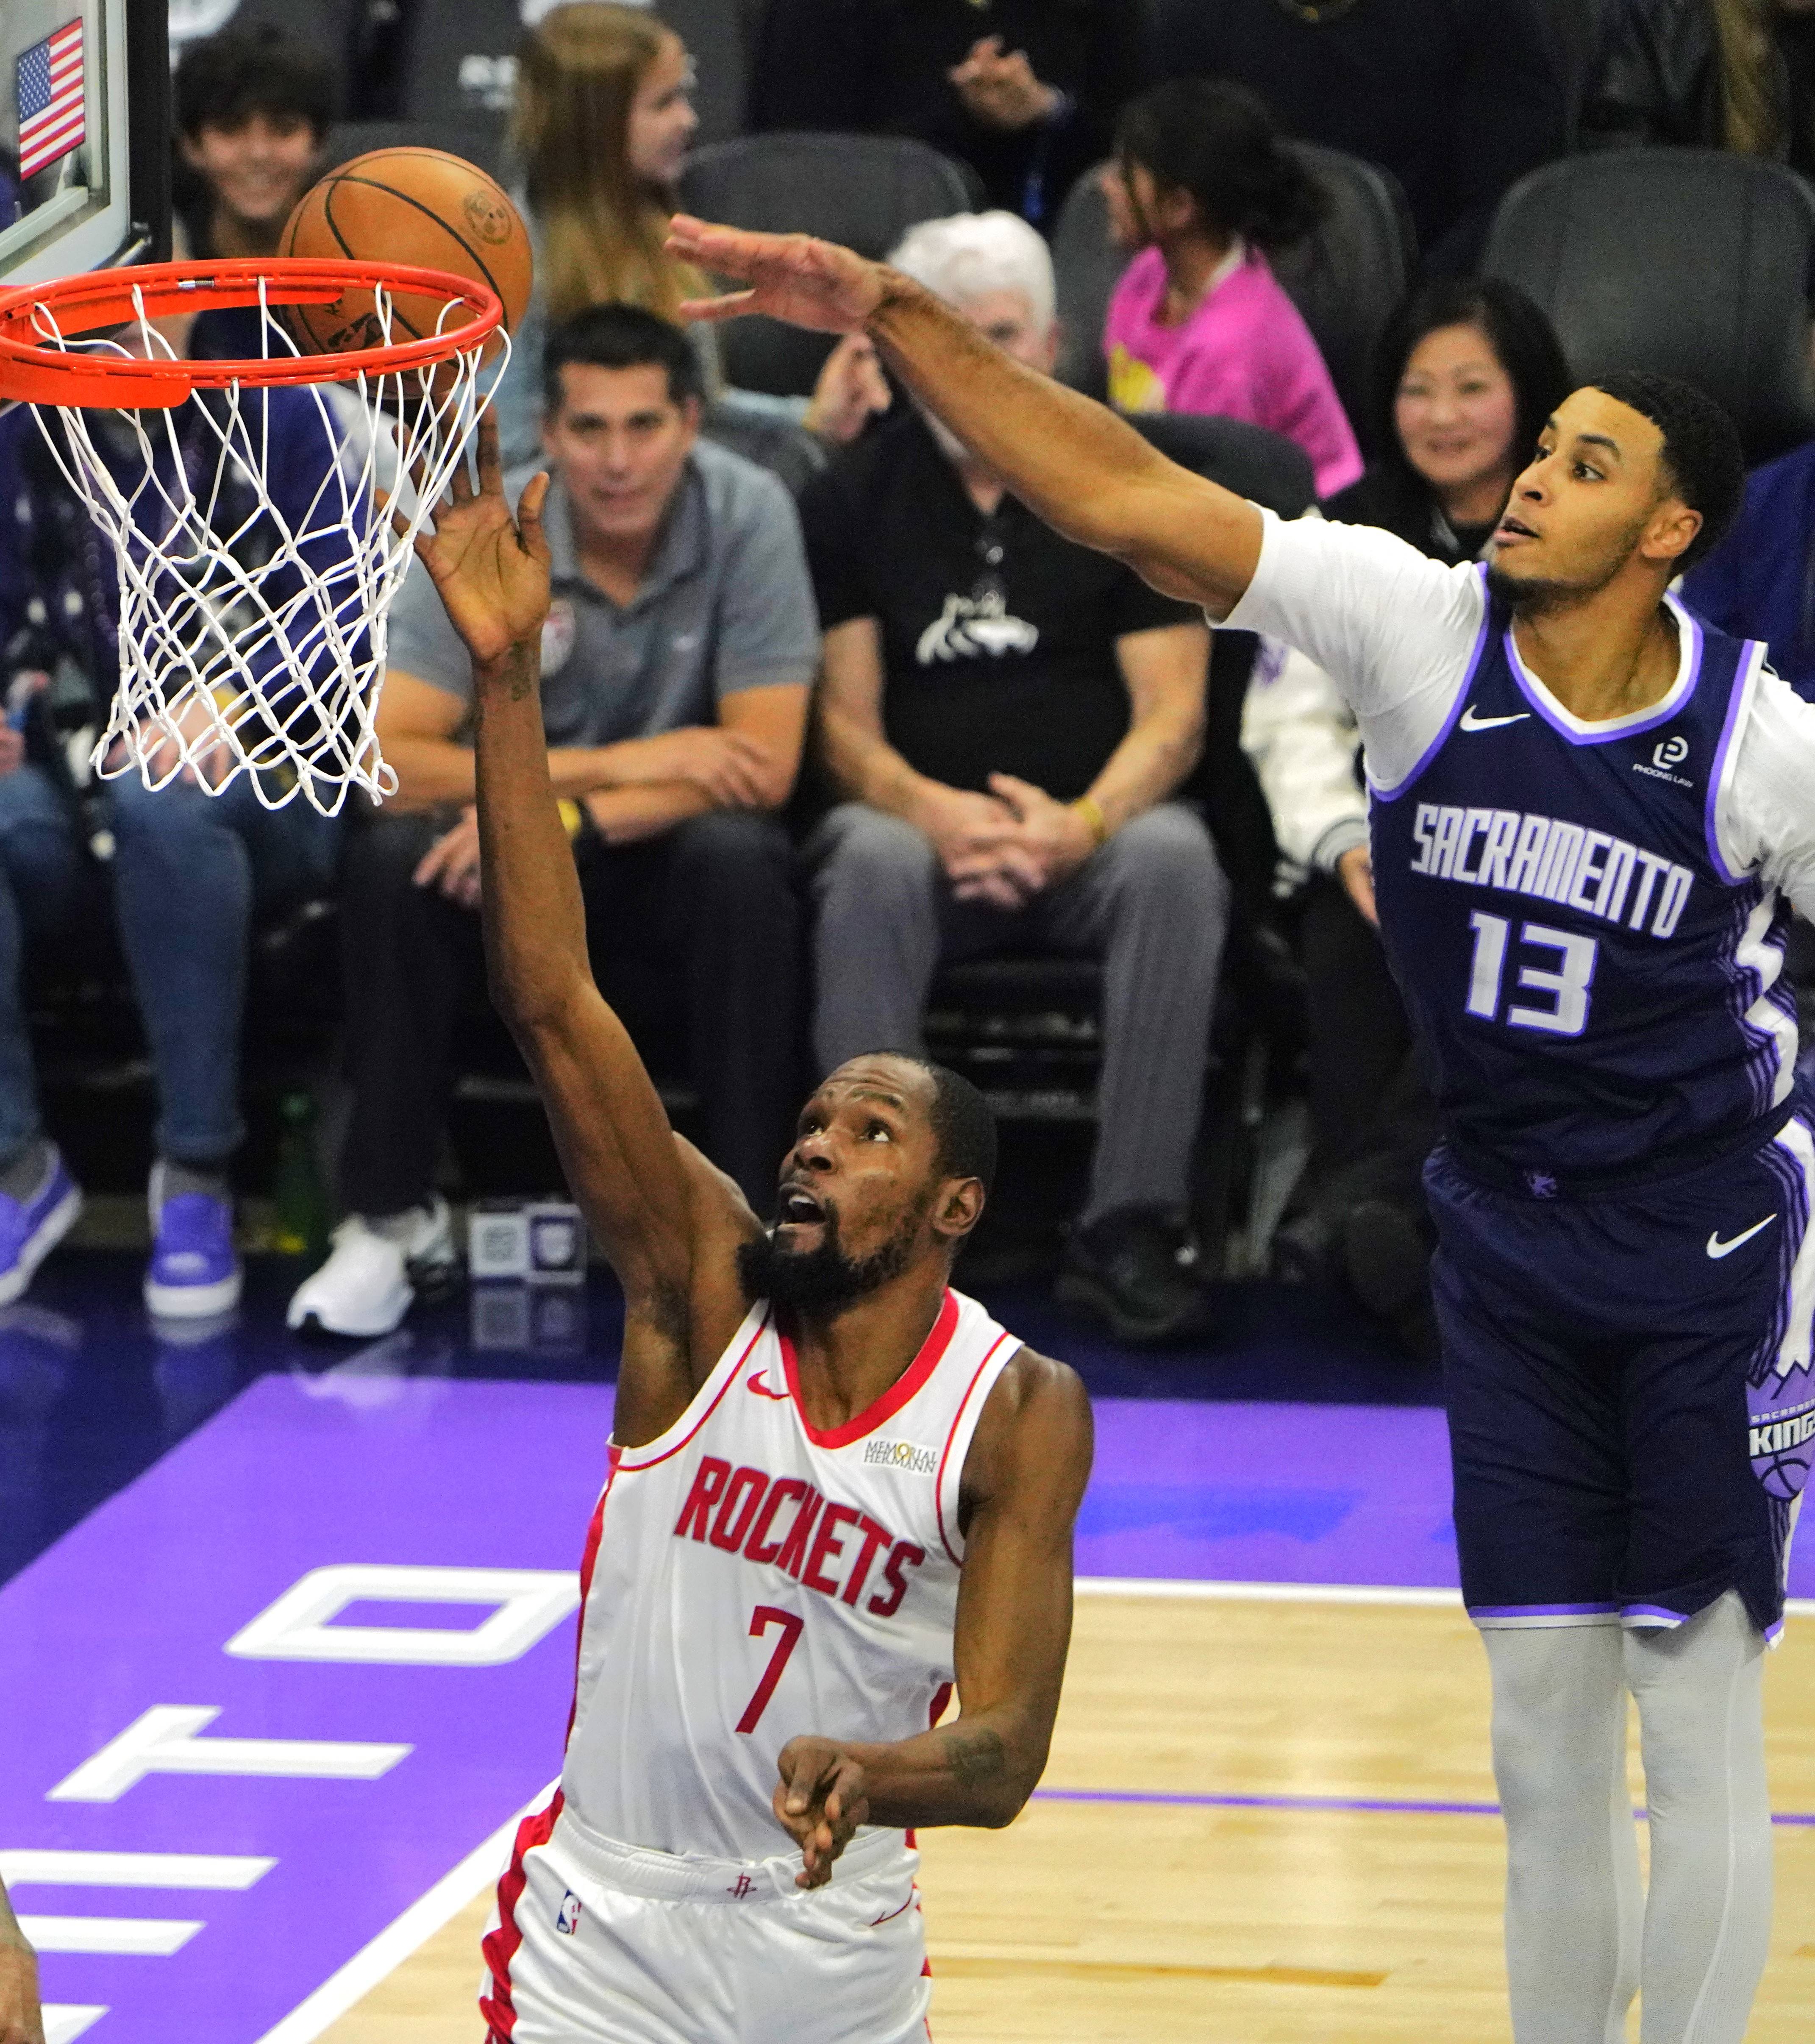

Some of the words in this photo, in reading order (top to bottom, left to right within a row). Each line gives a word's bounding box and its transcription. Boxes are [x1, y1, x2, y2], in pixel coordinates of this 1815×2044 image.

[1412, 803, 1695, 939] SACRAMENTO
[1465, 909, 1600, 1037] 13
[864, 1451, 936, 1474] HERMANN
[866, 1440, 937, 1463] MEMORIAL
[674, 1454, 926, 1617] ROCKETS
[735, 1605, 804, 1734] 7
